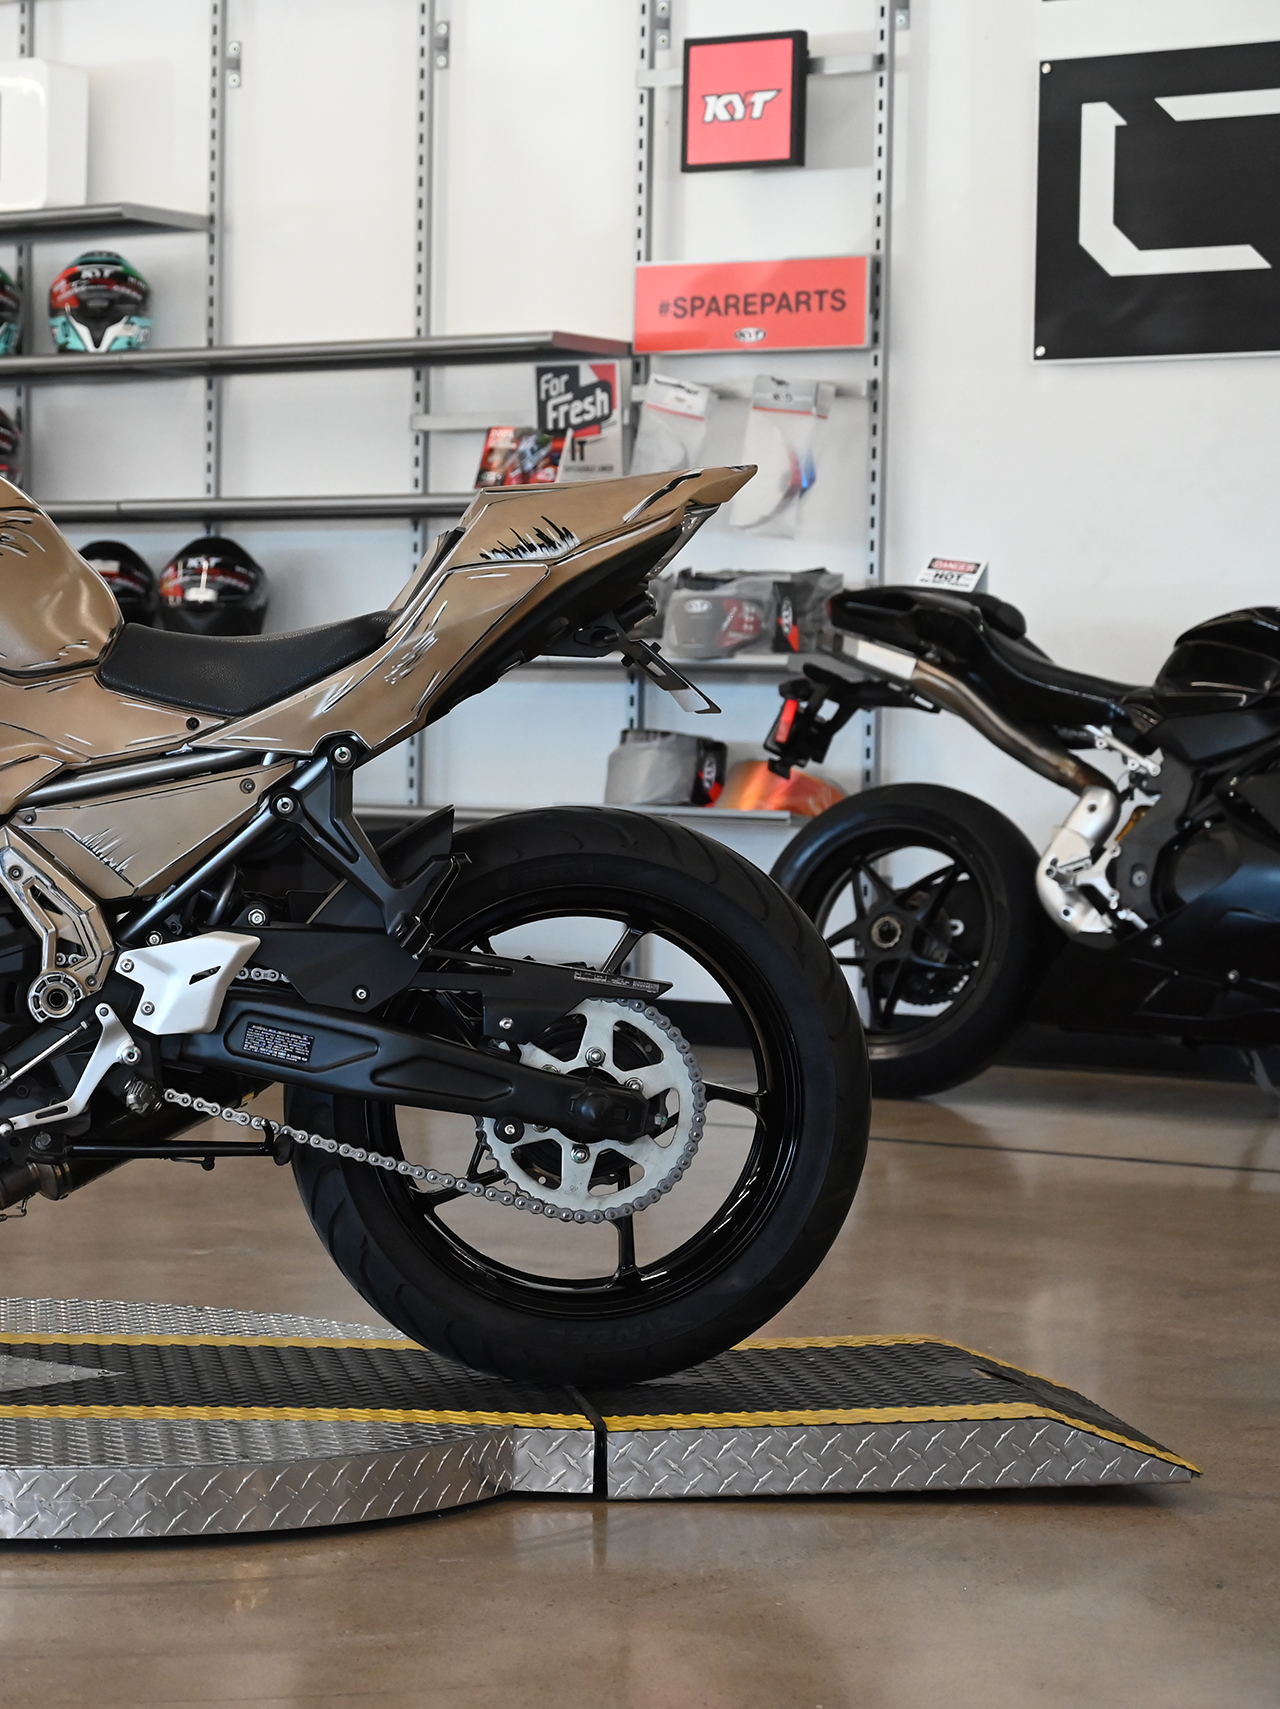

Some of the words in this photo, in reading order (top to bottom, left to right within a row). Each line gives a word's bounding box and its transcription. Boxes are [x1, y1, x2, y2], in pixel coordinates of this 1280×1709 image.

[702, 88, 782, 124] KYT
[658, 287, 848, 319] #SPAREPARTS
[539, 371, 570, 400] For
[546, 387, 610, 430] Fresh
